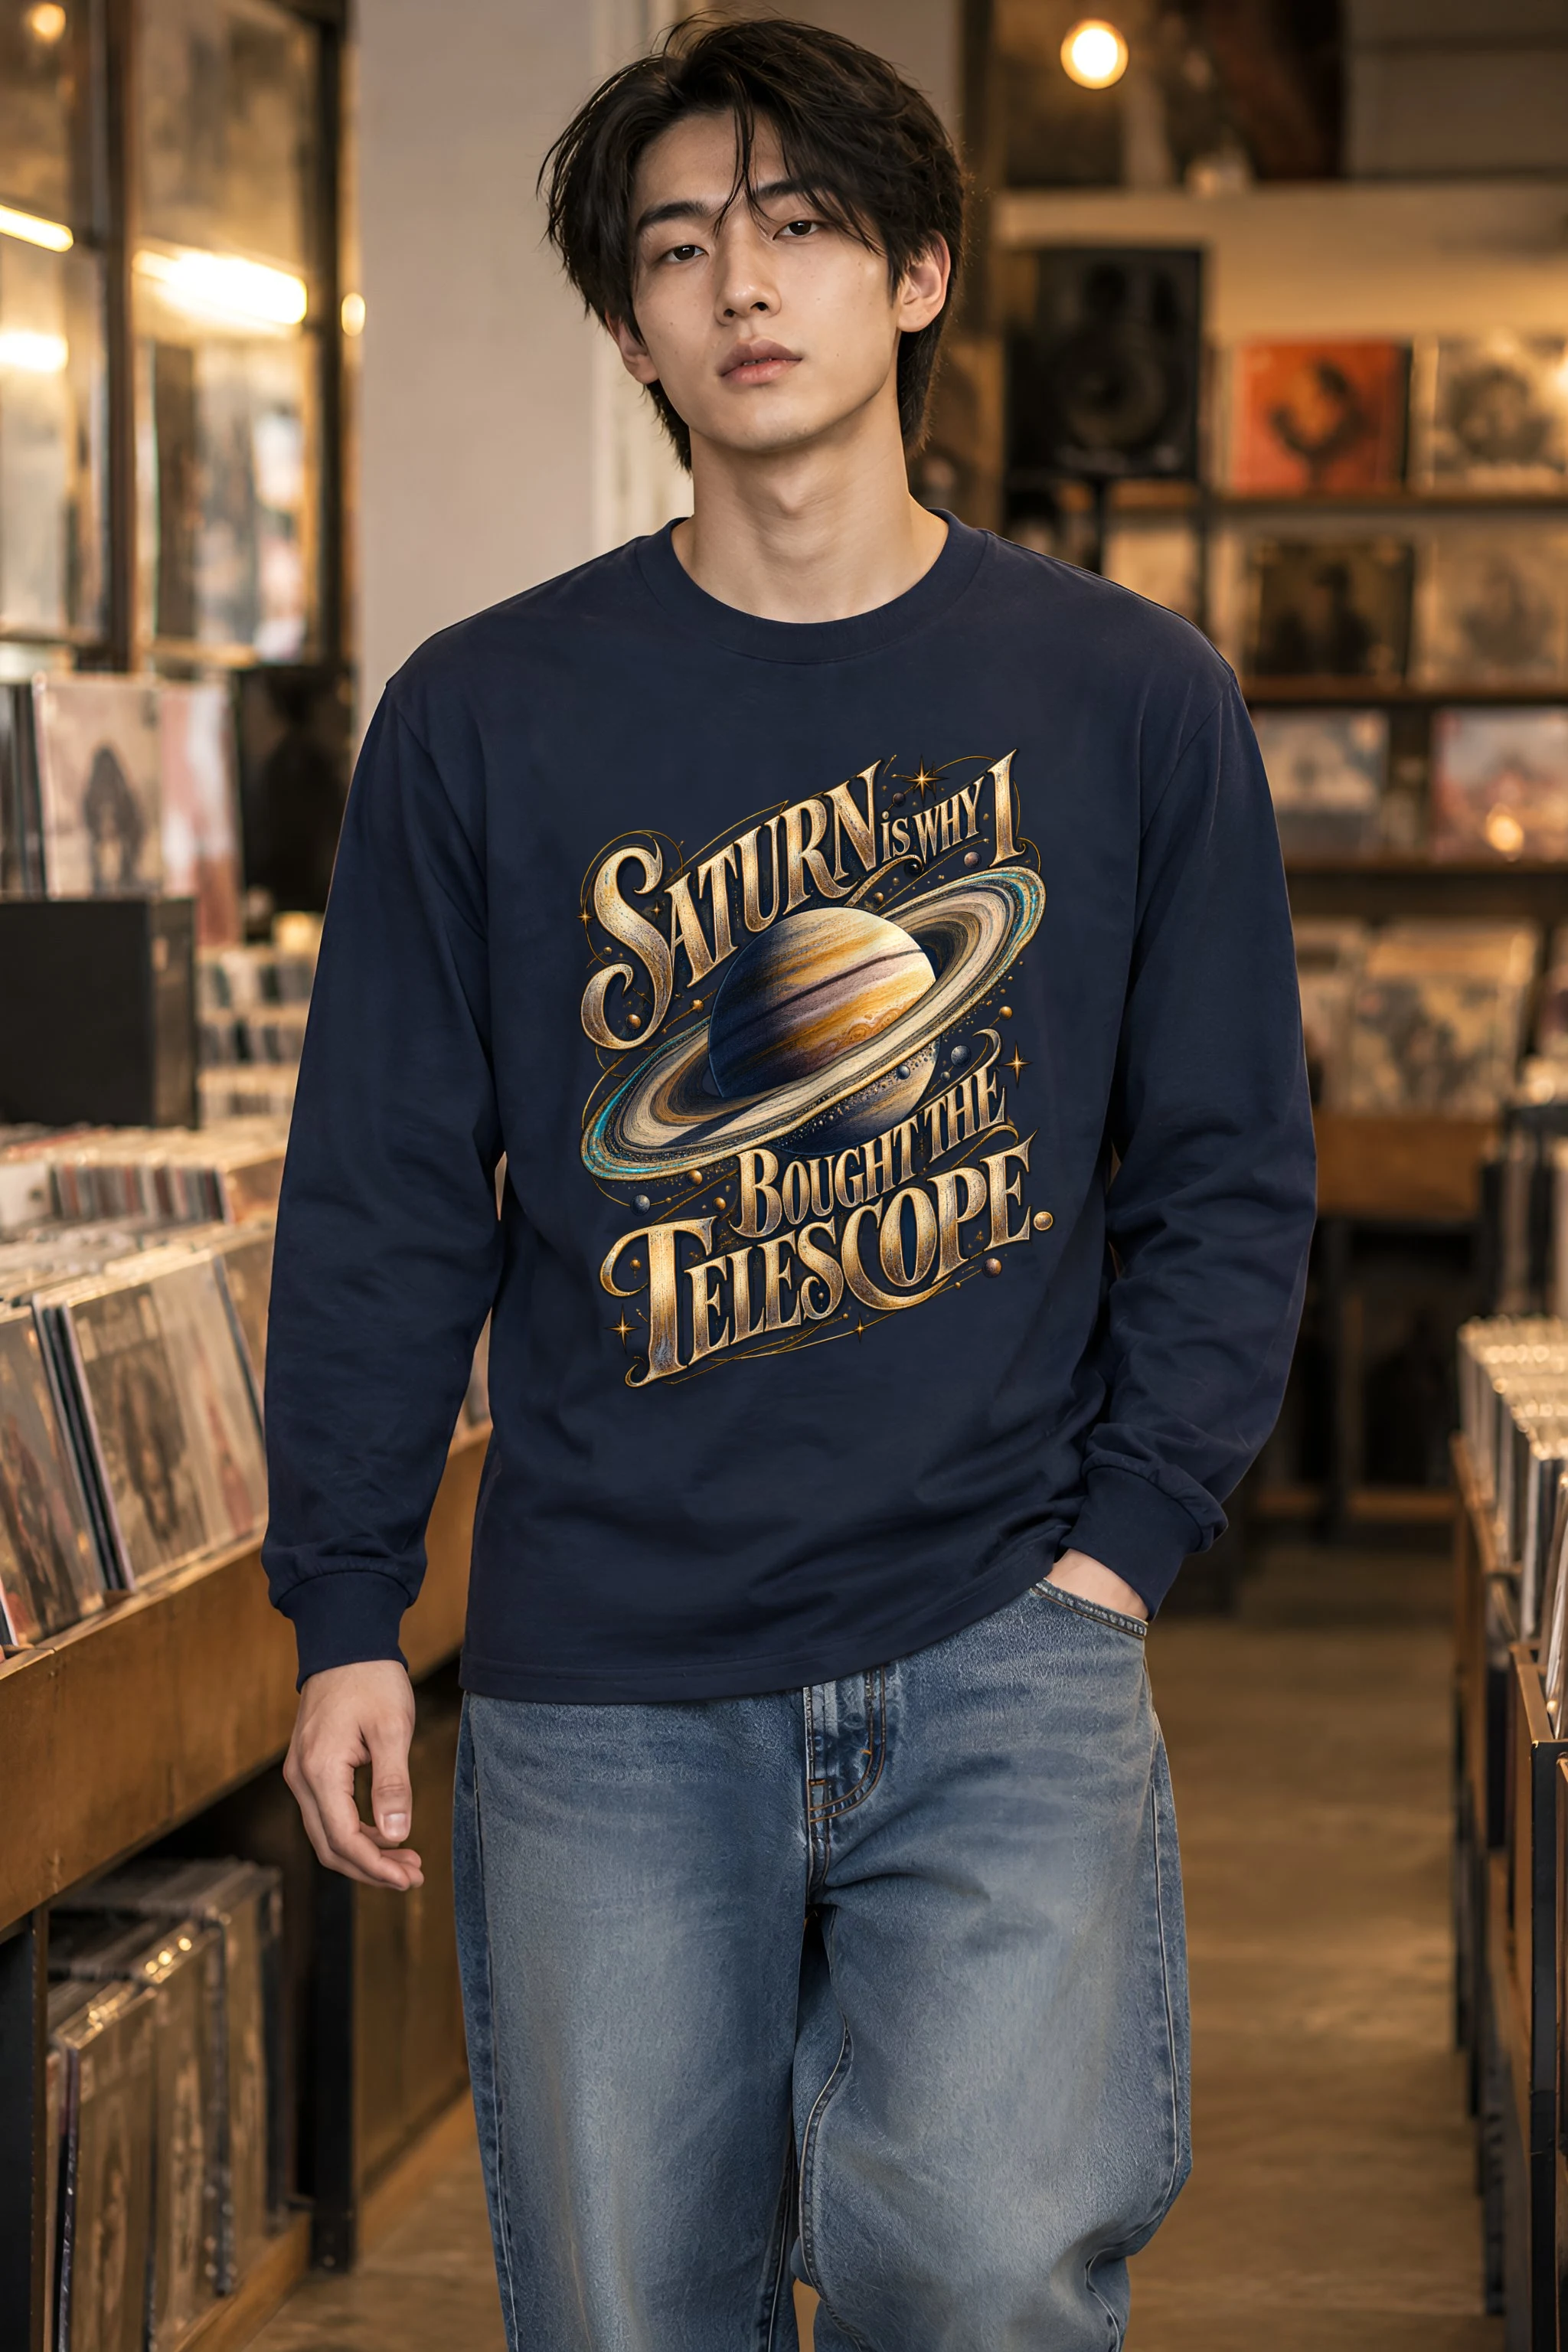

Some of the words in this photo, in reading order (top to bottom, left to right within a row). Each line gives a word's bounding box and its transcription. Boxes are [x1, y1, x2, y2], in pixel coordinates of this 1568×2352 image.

[580, 759, 882, 1050] SATURN
[912, 775, 985, 864] WHY
[988, 748, 1026, 867] I
[599, 1128, 1054, 1388] TELESCOPE.
[729, 1114, 920, 1239] BOUGHT
[923, 1028, 1006, 1164] THE
